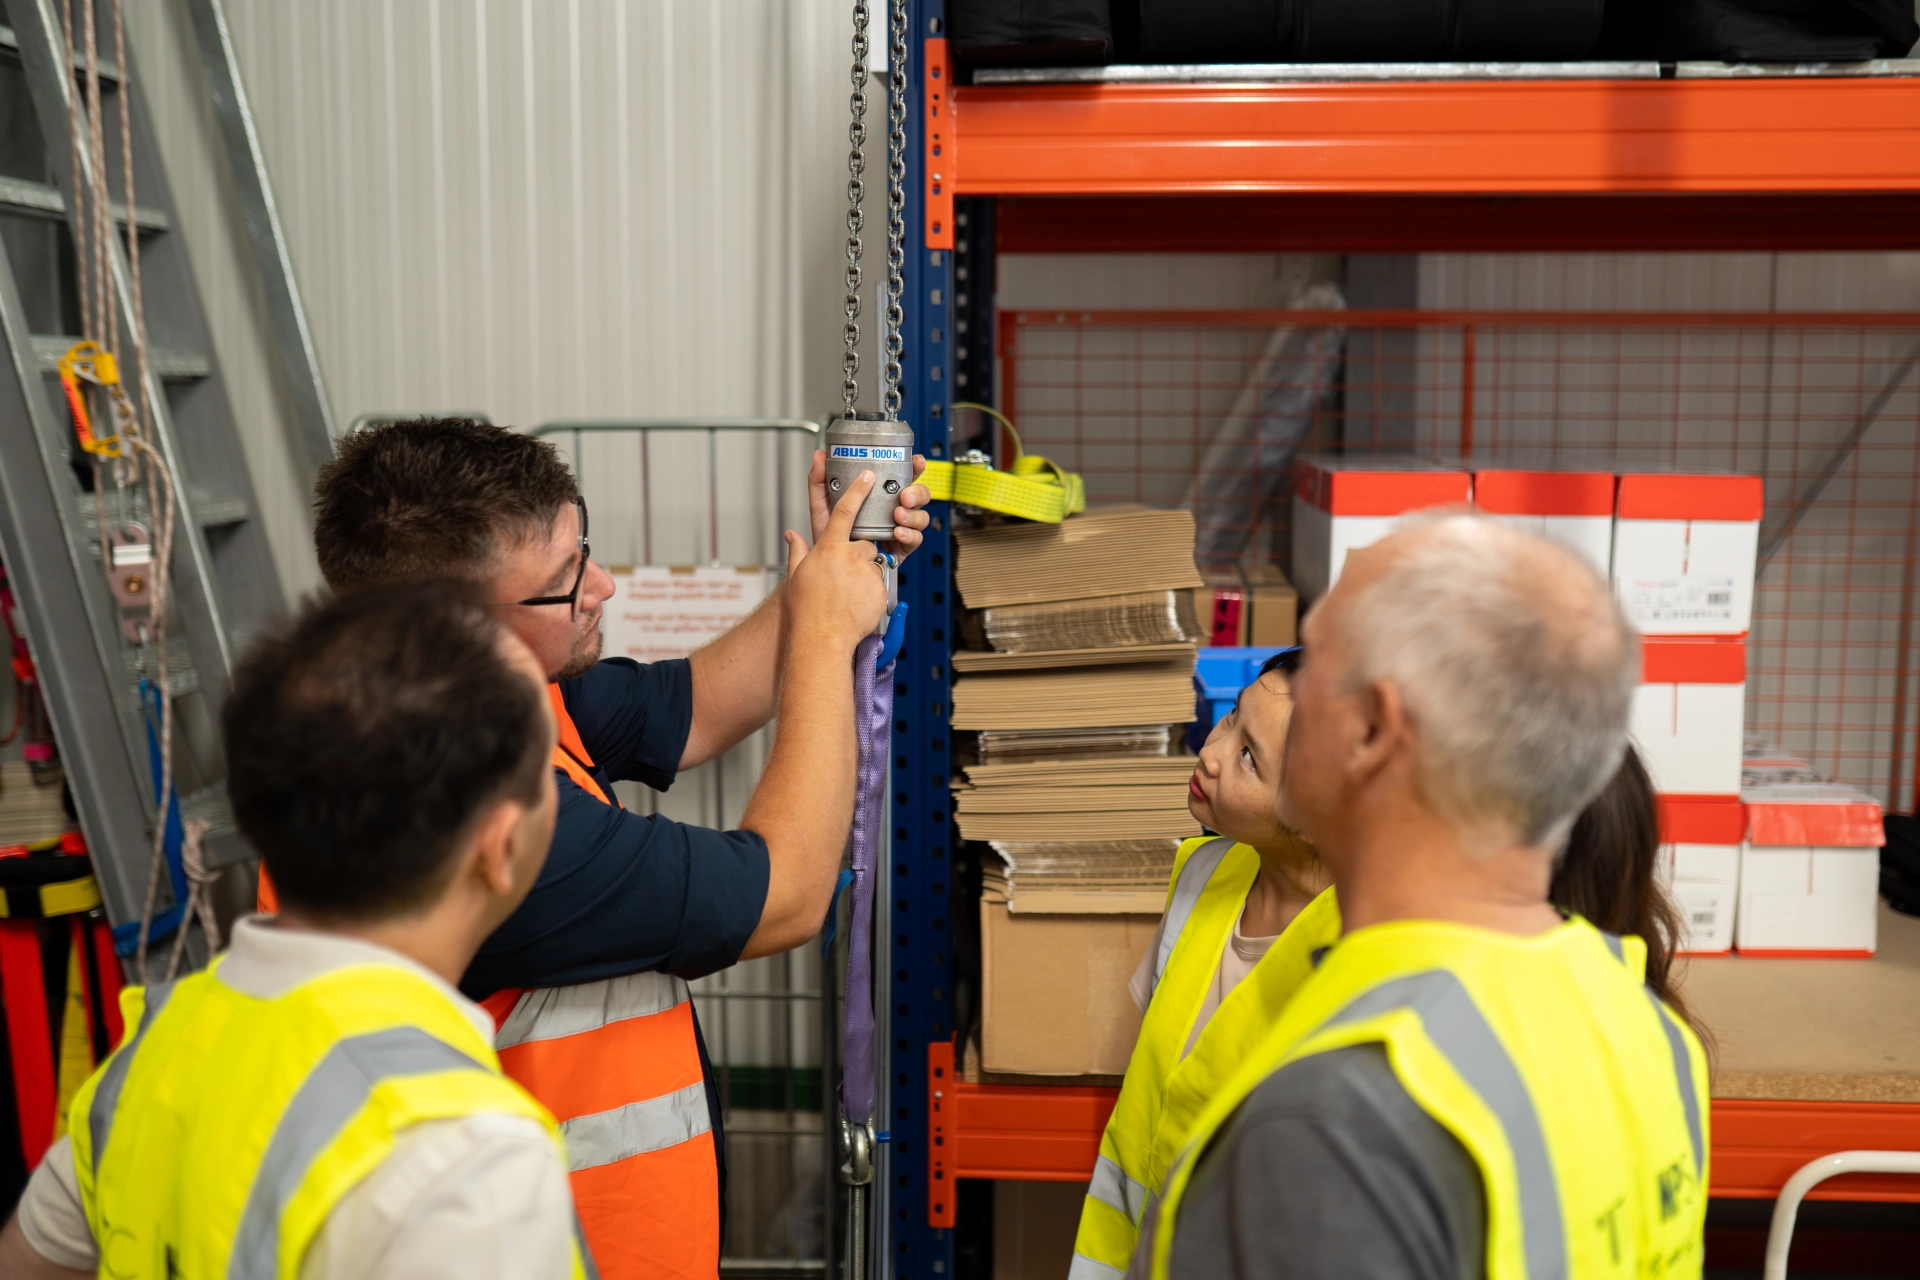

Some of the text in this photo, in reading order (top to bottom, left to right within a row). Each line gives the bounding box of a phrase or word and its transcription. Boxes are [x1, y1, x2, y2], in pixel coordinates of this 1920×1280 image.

[833, 447, 902, 460] ABUS 1000 kg
